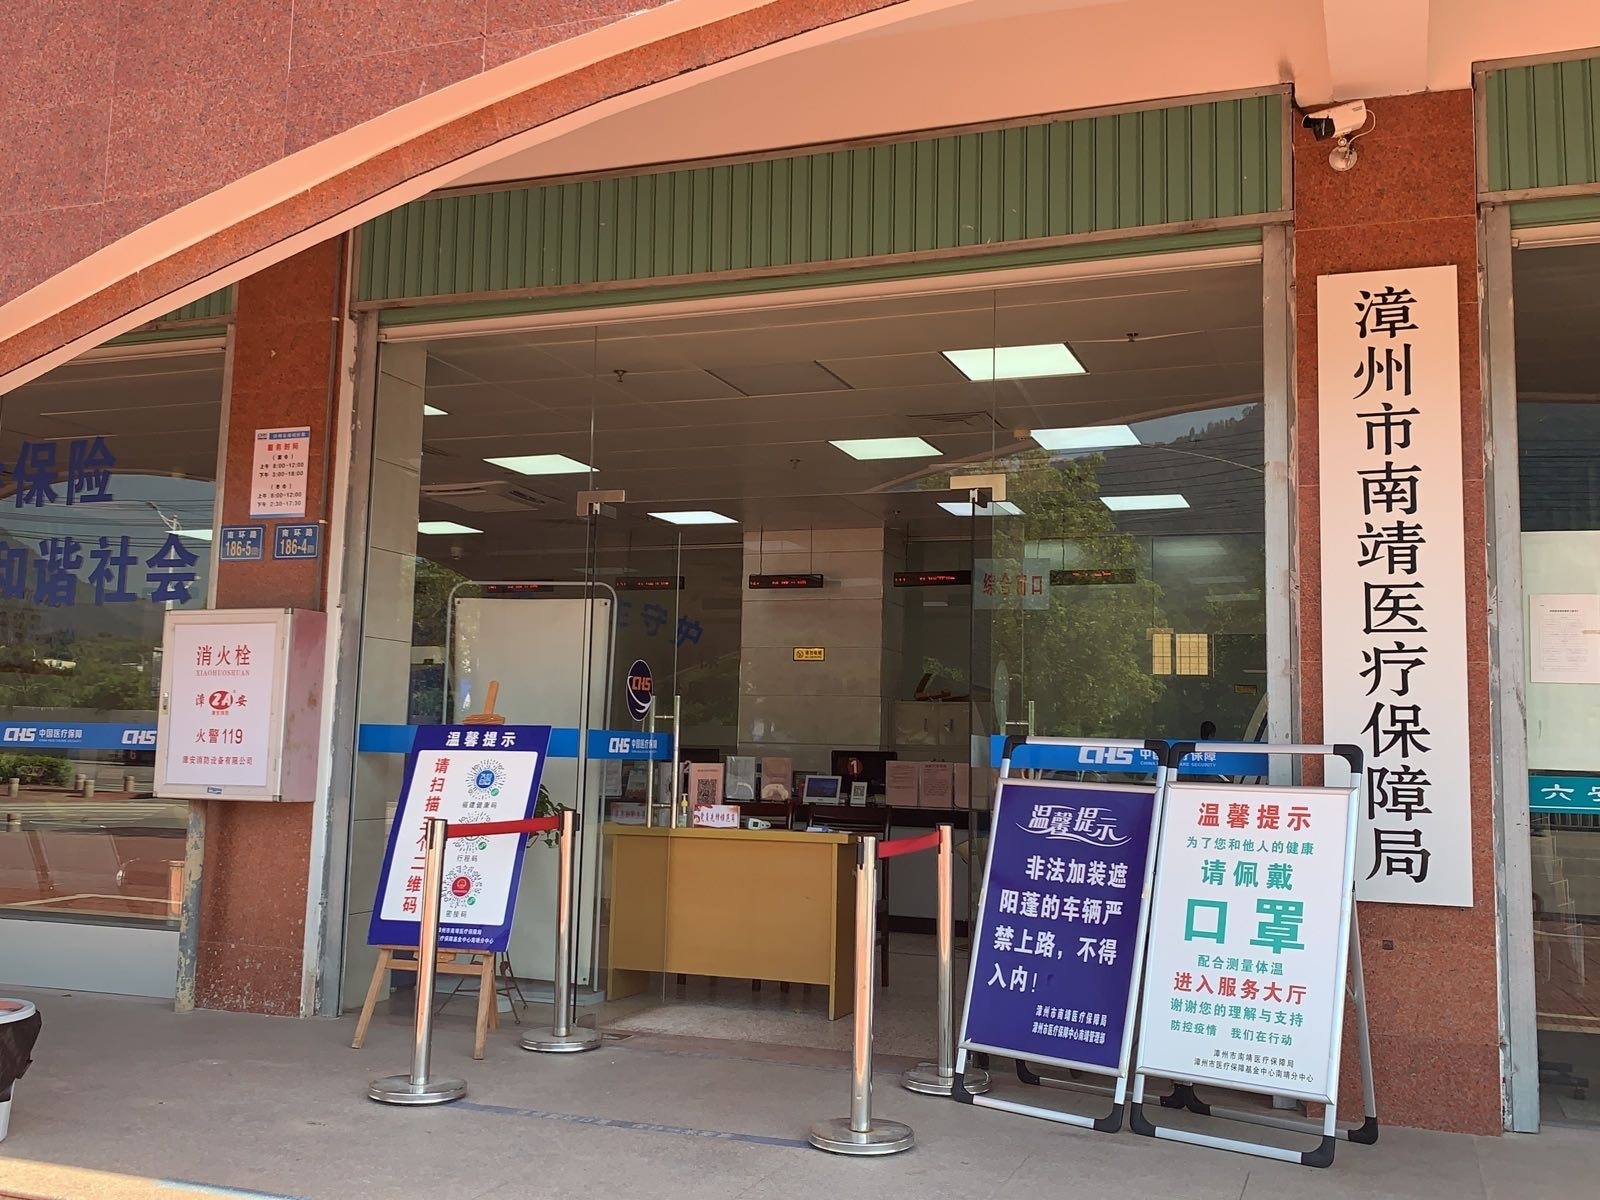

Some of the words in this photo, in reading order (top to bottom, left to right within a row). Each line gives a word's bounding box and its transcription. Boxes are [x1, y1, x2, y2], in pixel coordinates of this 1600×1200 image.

[0, 436, 116, 508] 保险
[227, 530, 258, 539] 南环路
[281, 528, 313, 538] 南环路
[1353, 286, 1433, 884] 漳州市南靖医疗保障局
[196, 644, 251, 667] 消火栓
[631, 676, 650, 692] CHS
[3, 727, 37, 742] CHS
[38, 728, 83, 739] 中国医疗保障
[122, 729, 157, 745] CHS
[446, 731, 516, 748] 温馨提示
[608, 737, 630, 753] CHS
[1078, 746, 1134, 765] CHS
[462, 801, 498, 809] 福建健康码
[1197, 801, 1312, 832] 温馨提示
[1028, 804, 1118, 842] 温馨提示
[1186, 836, 1315, 856] 为了您和他人的健康
[456, 854, 478, 863] 行程码
[1025, 855, 1129, 889] 非法加装遮
[1201, 859, 1293, 890] 请佩戴
[999, 888, 1124, 926] 阳蓬的车辆严
[1184, 896, 1305, 954] 口罩
[993, 924, 1118, 966] 禁上路，不得
[1197, 954, 1284, 976] 配合测量体温
[1173, 971, 1307, 1005] 进入服务大厅
[1035, 1004, 1108, 1027] 漳州市南靖医疗保障局
[1170, 997, 1304, 1027] 谢谢您的理解与支持
[1170, 1019, 1217, 1038] 防控疫情
[1231, 1028, 1293, 1046] 我们在行动
[1213, 1048, 1294, 1068] 漳州市南靖医疗保障局
[1193, 1057, 1314, 1083] 漳州市医疗保障基金中心南靖分中心
